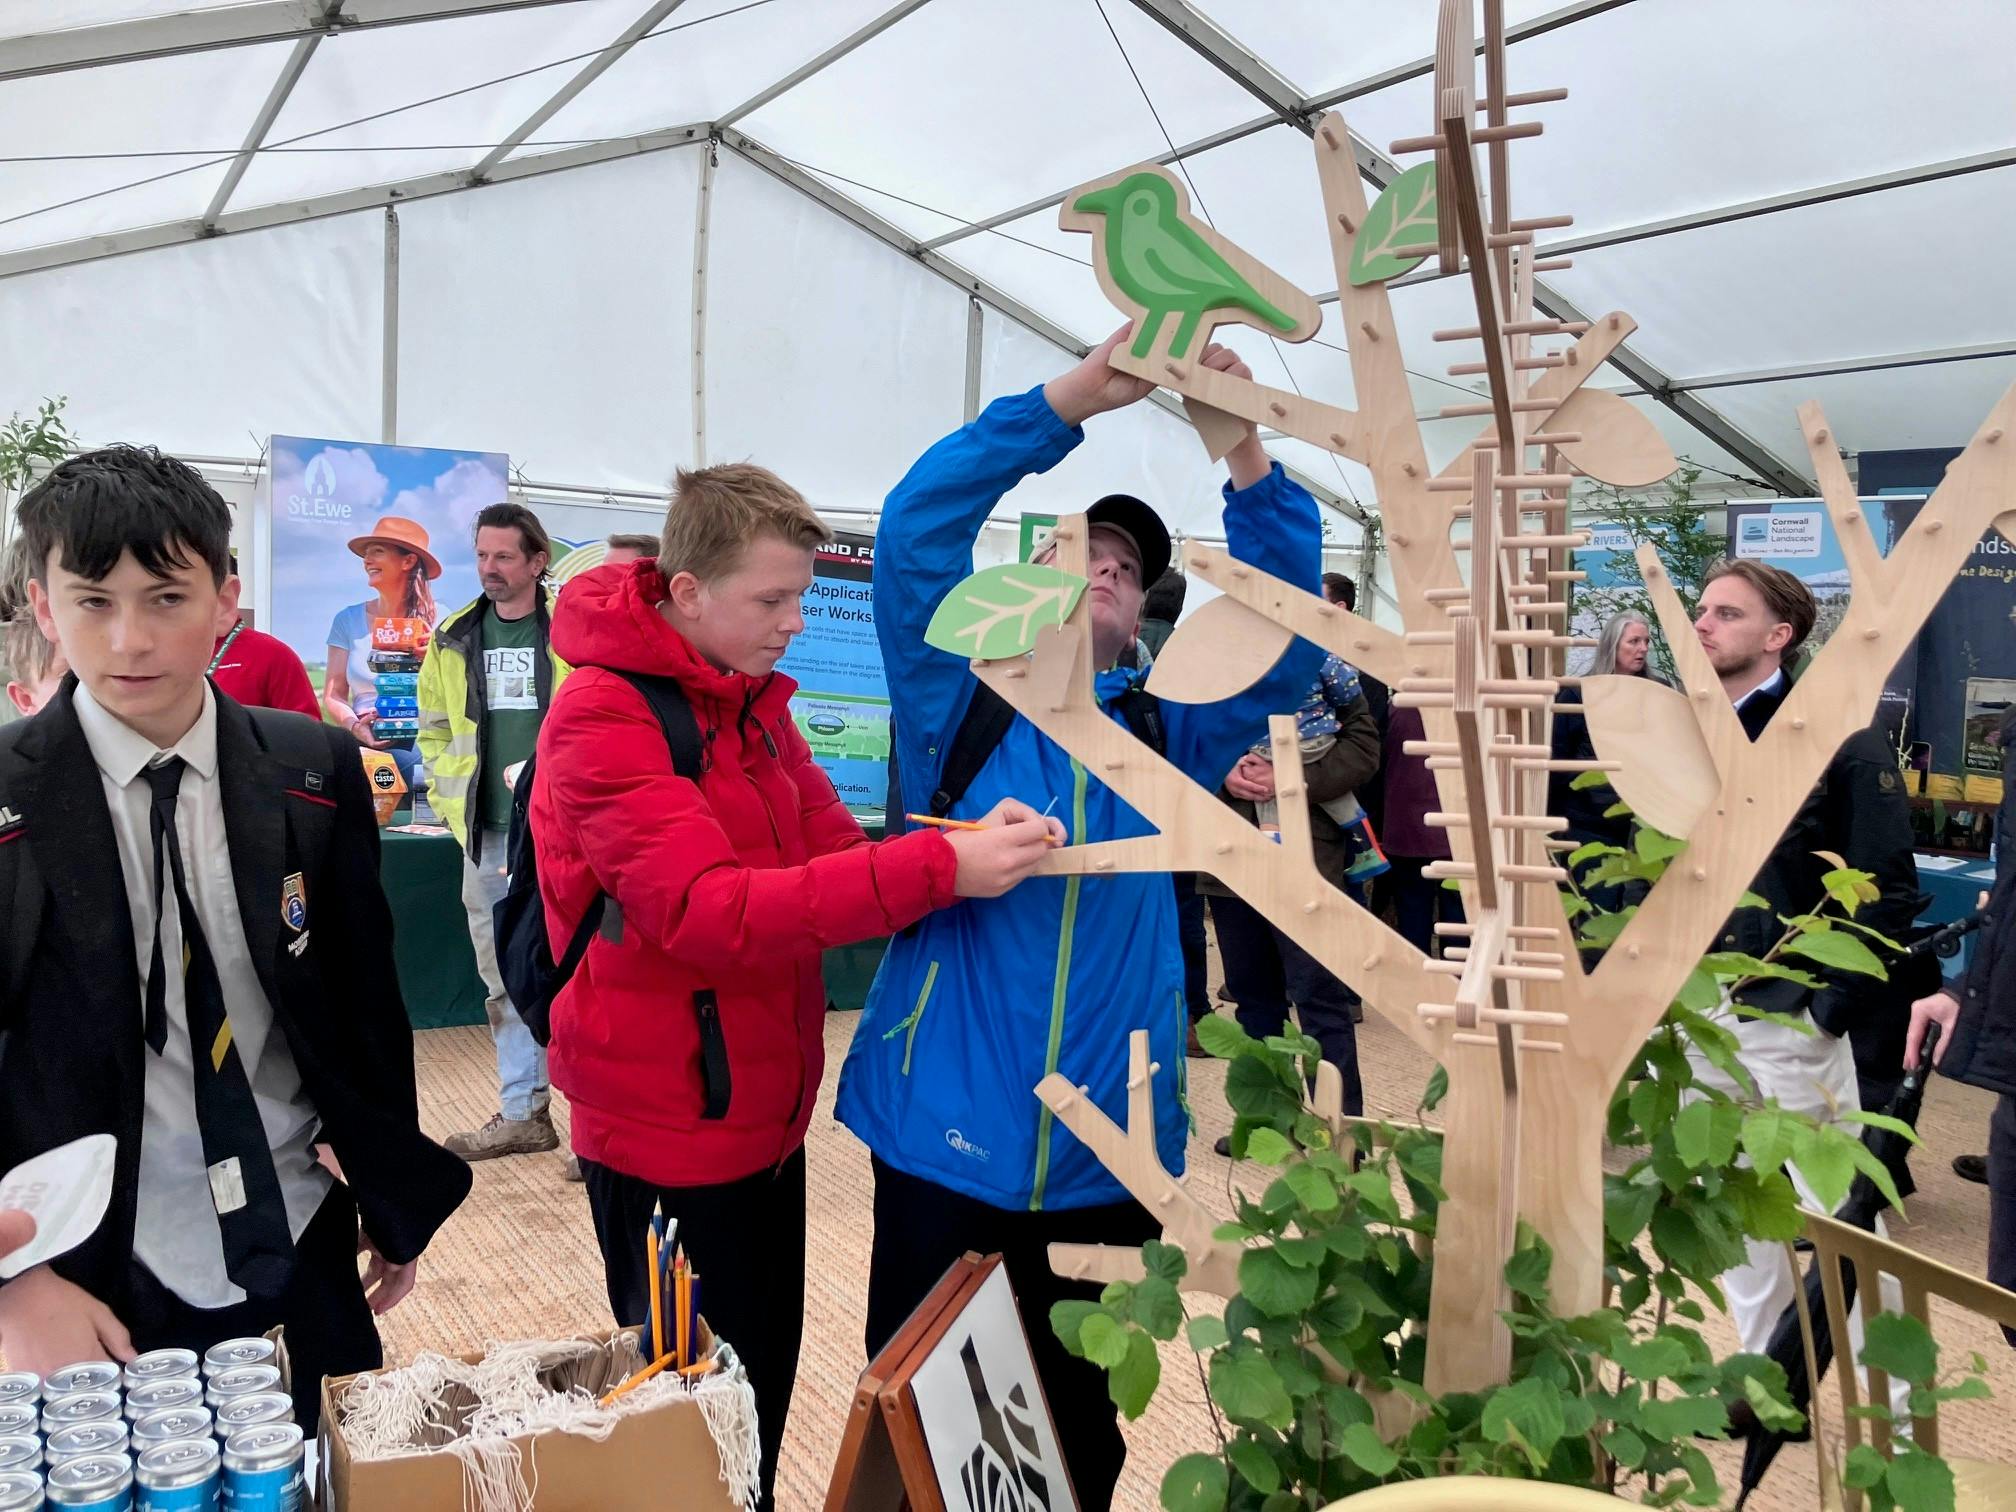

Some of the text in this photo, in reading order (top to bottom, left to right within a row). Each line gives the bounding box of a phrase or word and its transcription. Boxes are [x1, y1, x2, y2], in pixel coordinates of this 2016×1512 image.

[1771, 518, 1809, 526] Cornwall
[1771, 526, 1806, 534] National
[1593, 535, 1628, 546] RIVERS
[1771, 535, 1815, 543] Landscape
[802, 605, 876, 623] ser Works.
[485, 650, 535, 674] FES
[387, 709, 417, 718] LARGE
[374, 775, 395, 783] taste
